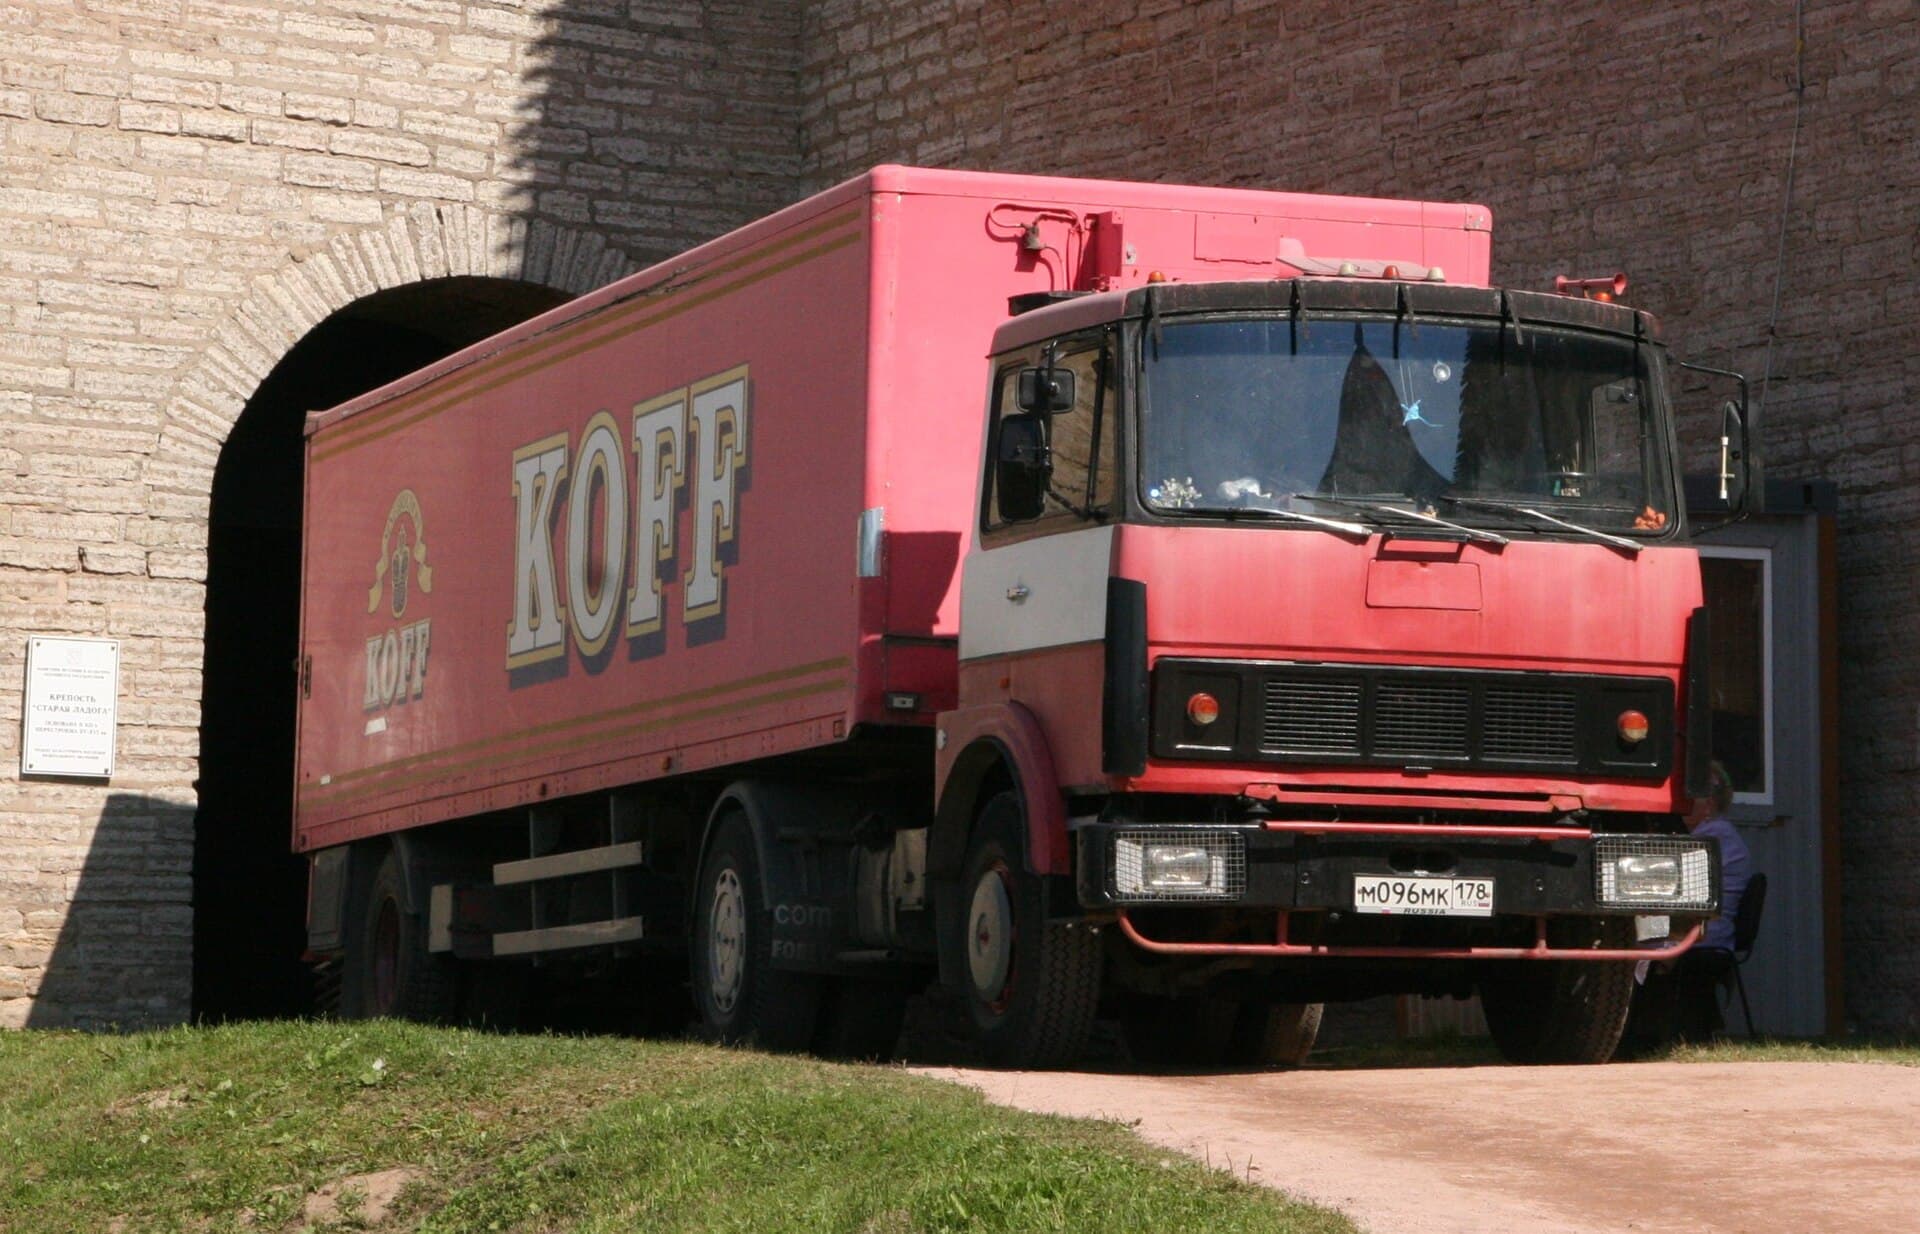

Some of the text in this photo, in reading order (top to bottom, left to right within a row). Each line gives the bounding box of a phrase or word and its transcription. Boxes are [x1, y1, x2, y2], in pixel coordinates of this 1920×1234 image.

[506, 364, 751, 680] KOFF
[364, 618, 431, 711] KOFF
[49, 693, 96, 702] КРЕПОСТЬ
[1455, 883, 1486, 900] 178
[1403, 907, 1446, 915] RUSSIA
